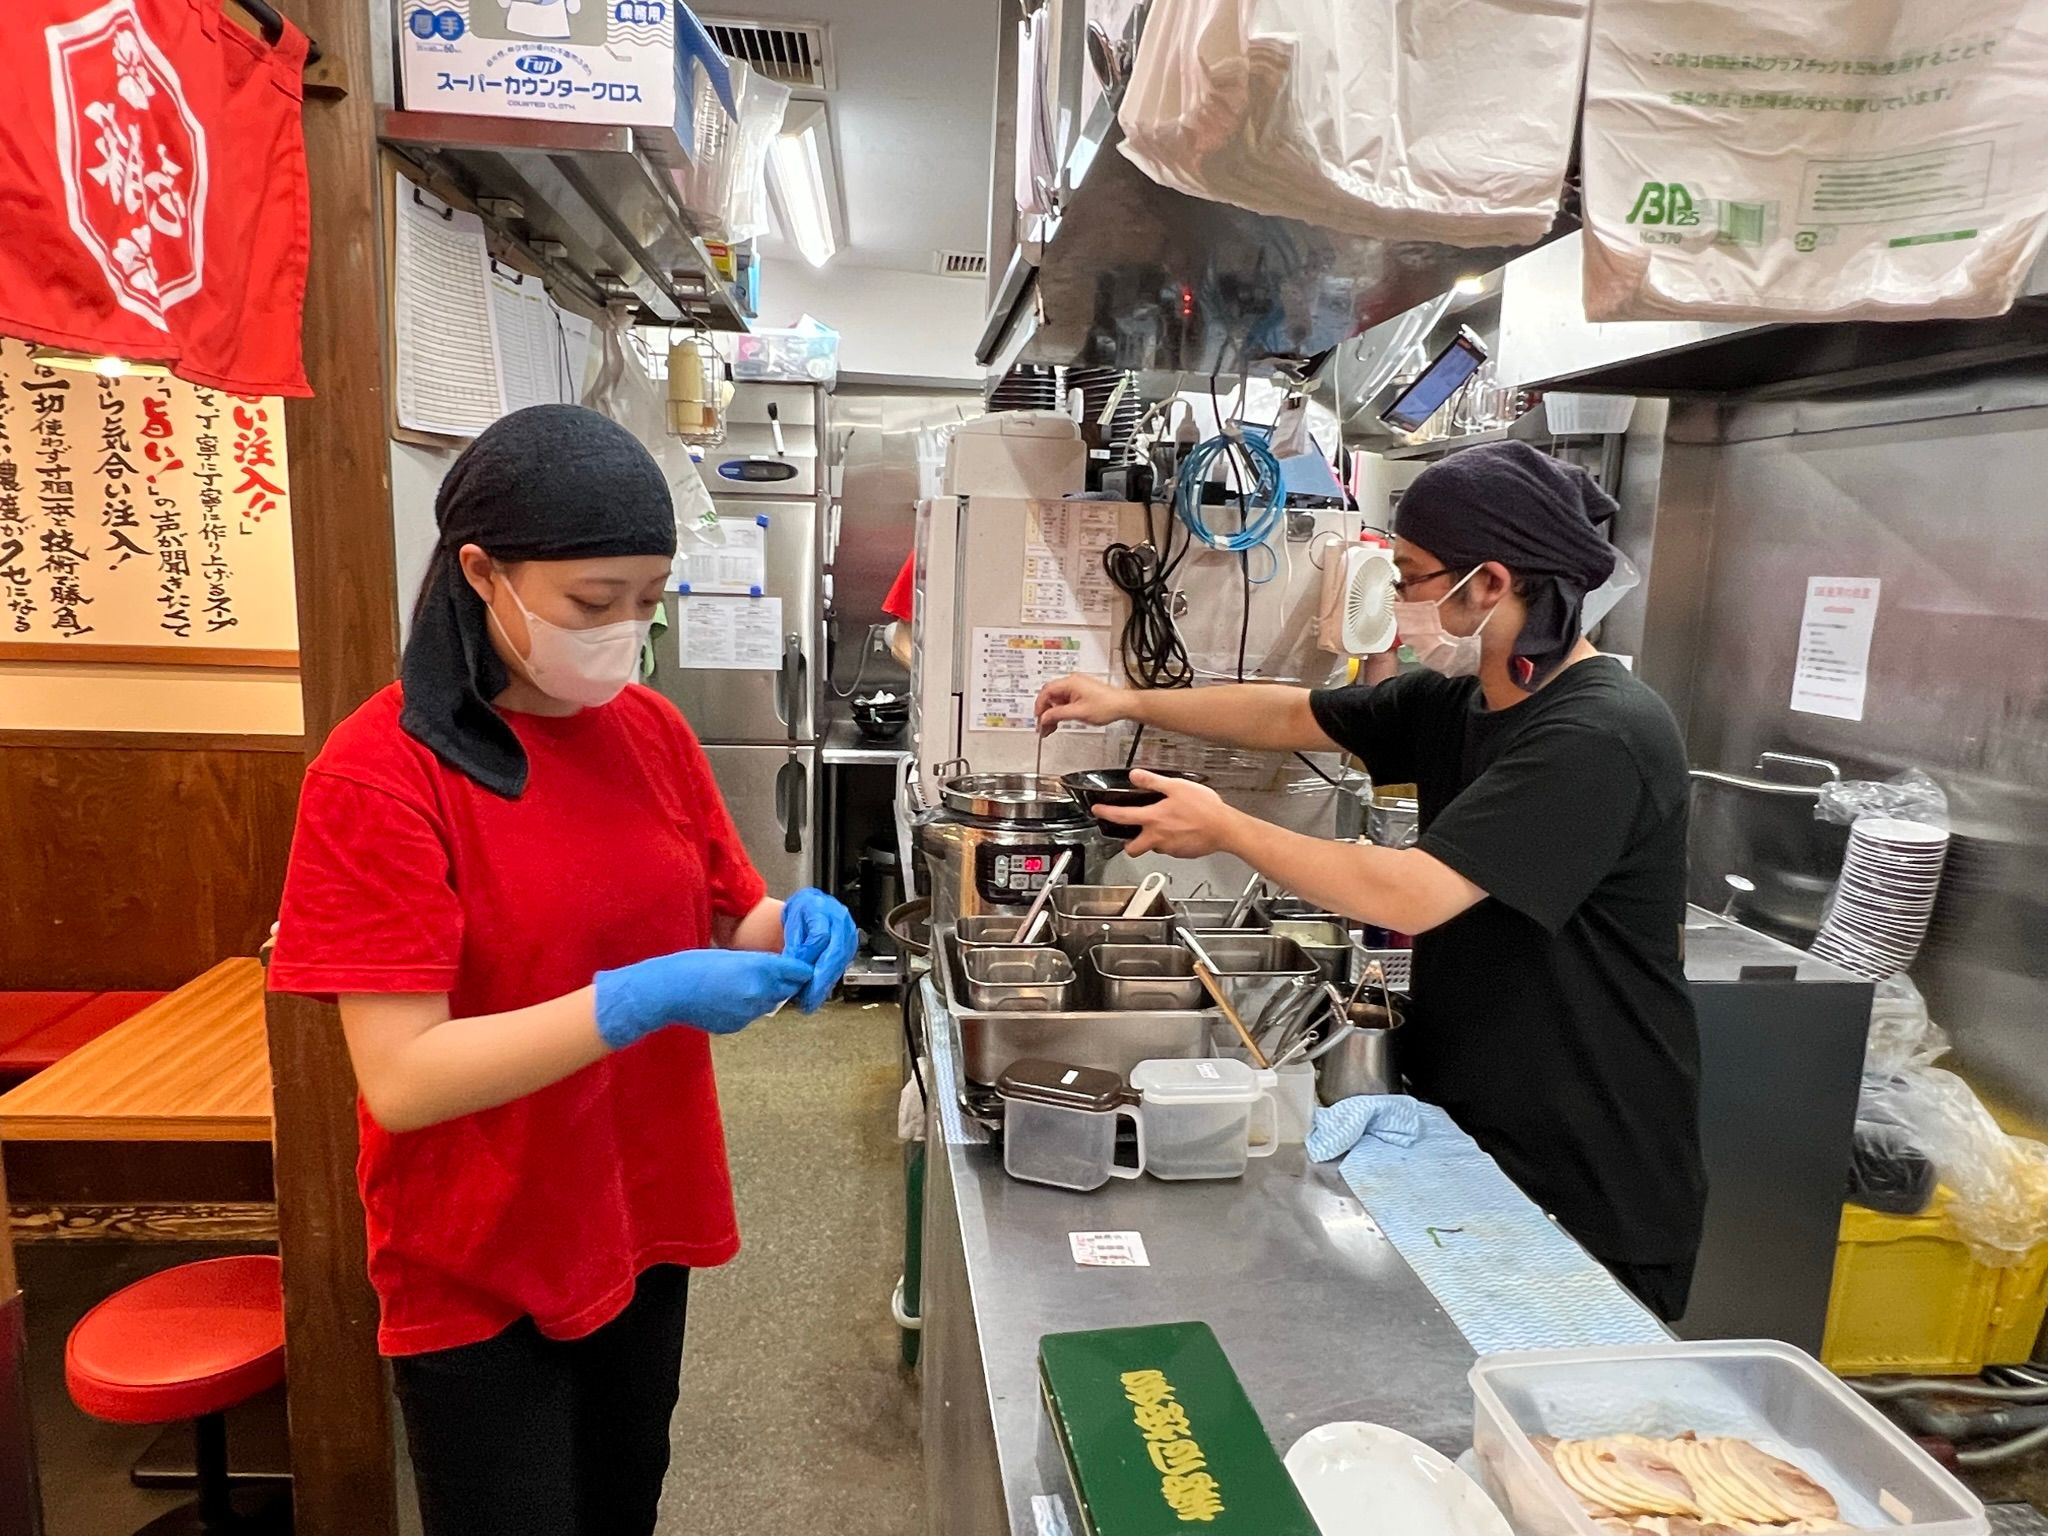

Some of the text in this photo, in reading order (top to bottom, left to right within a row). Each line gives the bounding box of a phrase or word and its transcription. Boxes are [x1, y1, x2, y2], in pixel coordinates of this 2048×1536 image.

[618, 4, 662, 23] 業務用
[521, 56, 558, 75] Fuji
[437, 72, 642, 103] スーパーカウンタークロス
[226, 394, 287, 535] い注入!!」
[140, 377, 192, 637] 「旨い!」の声が聞きたくて
